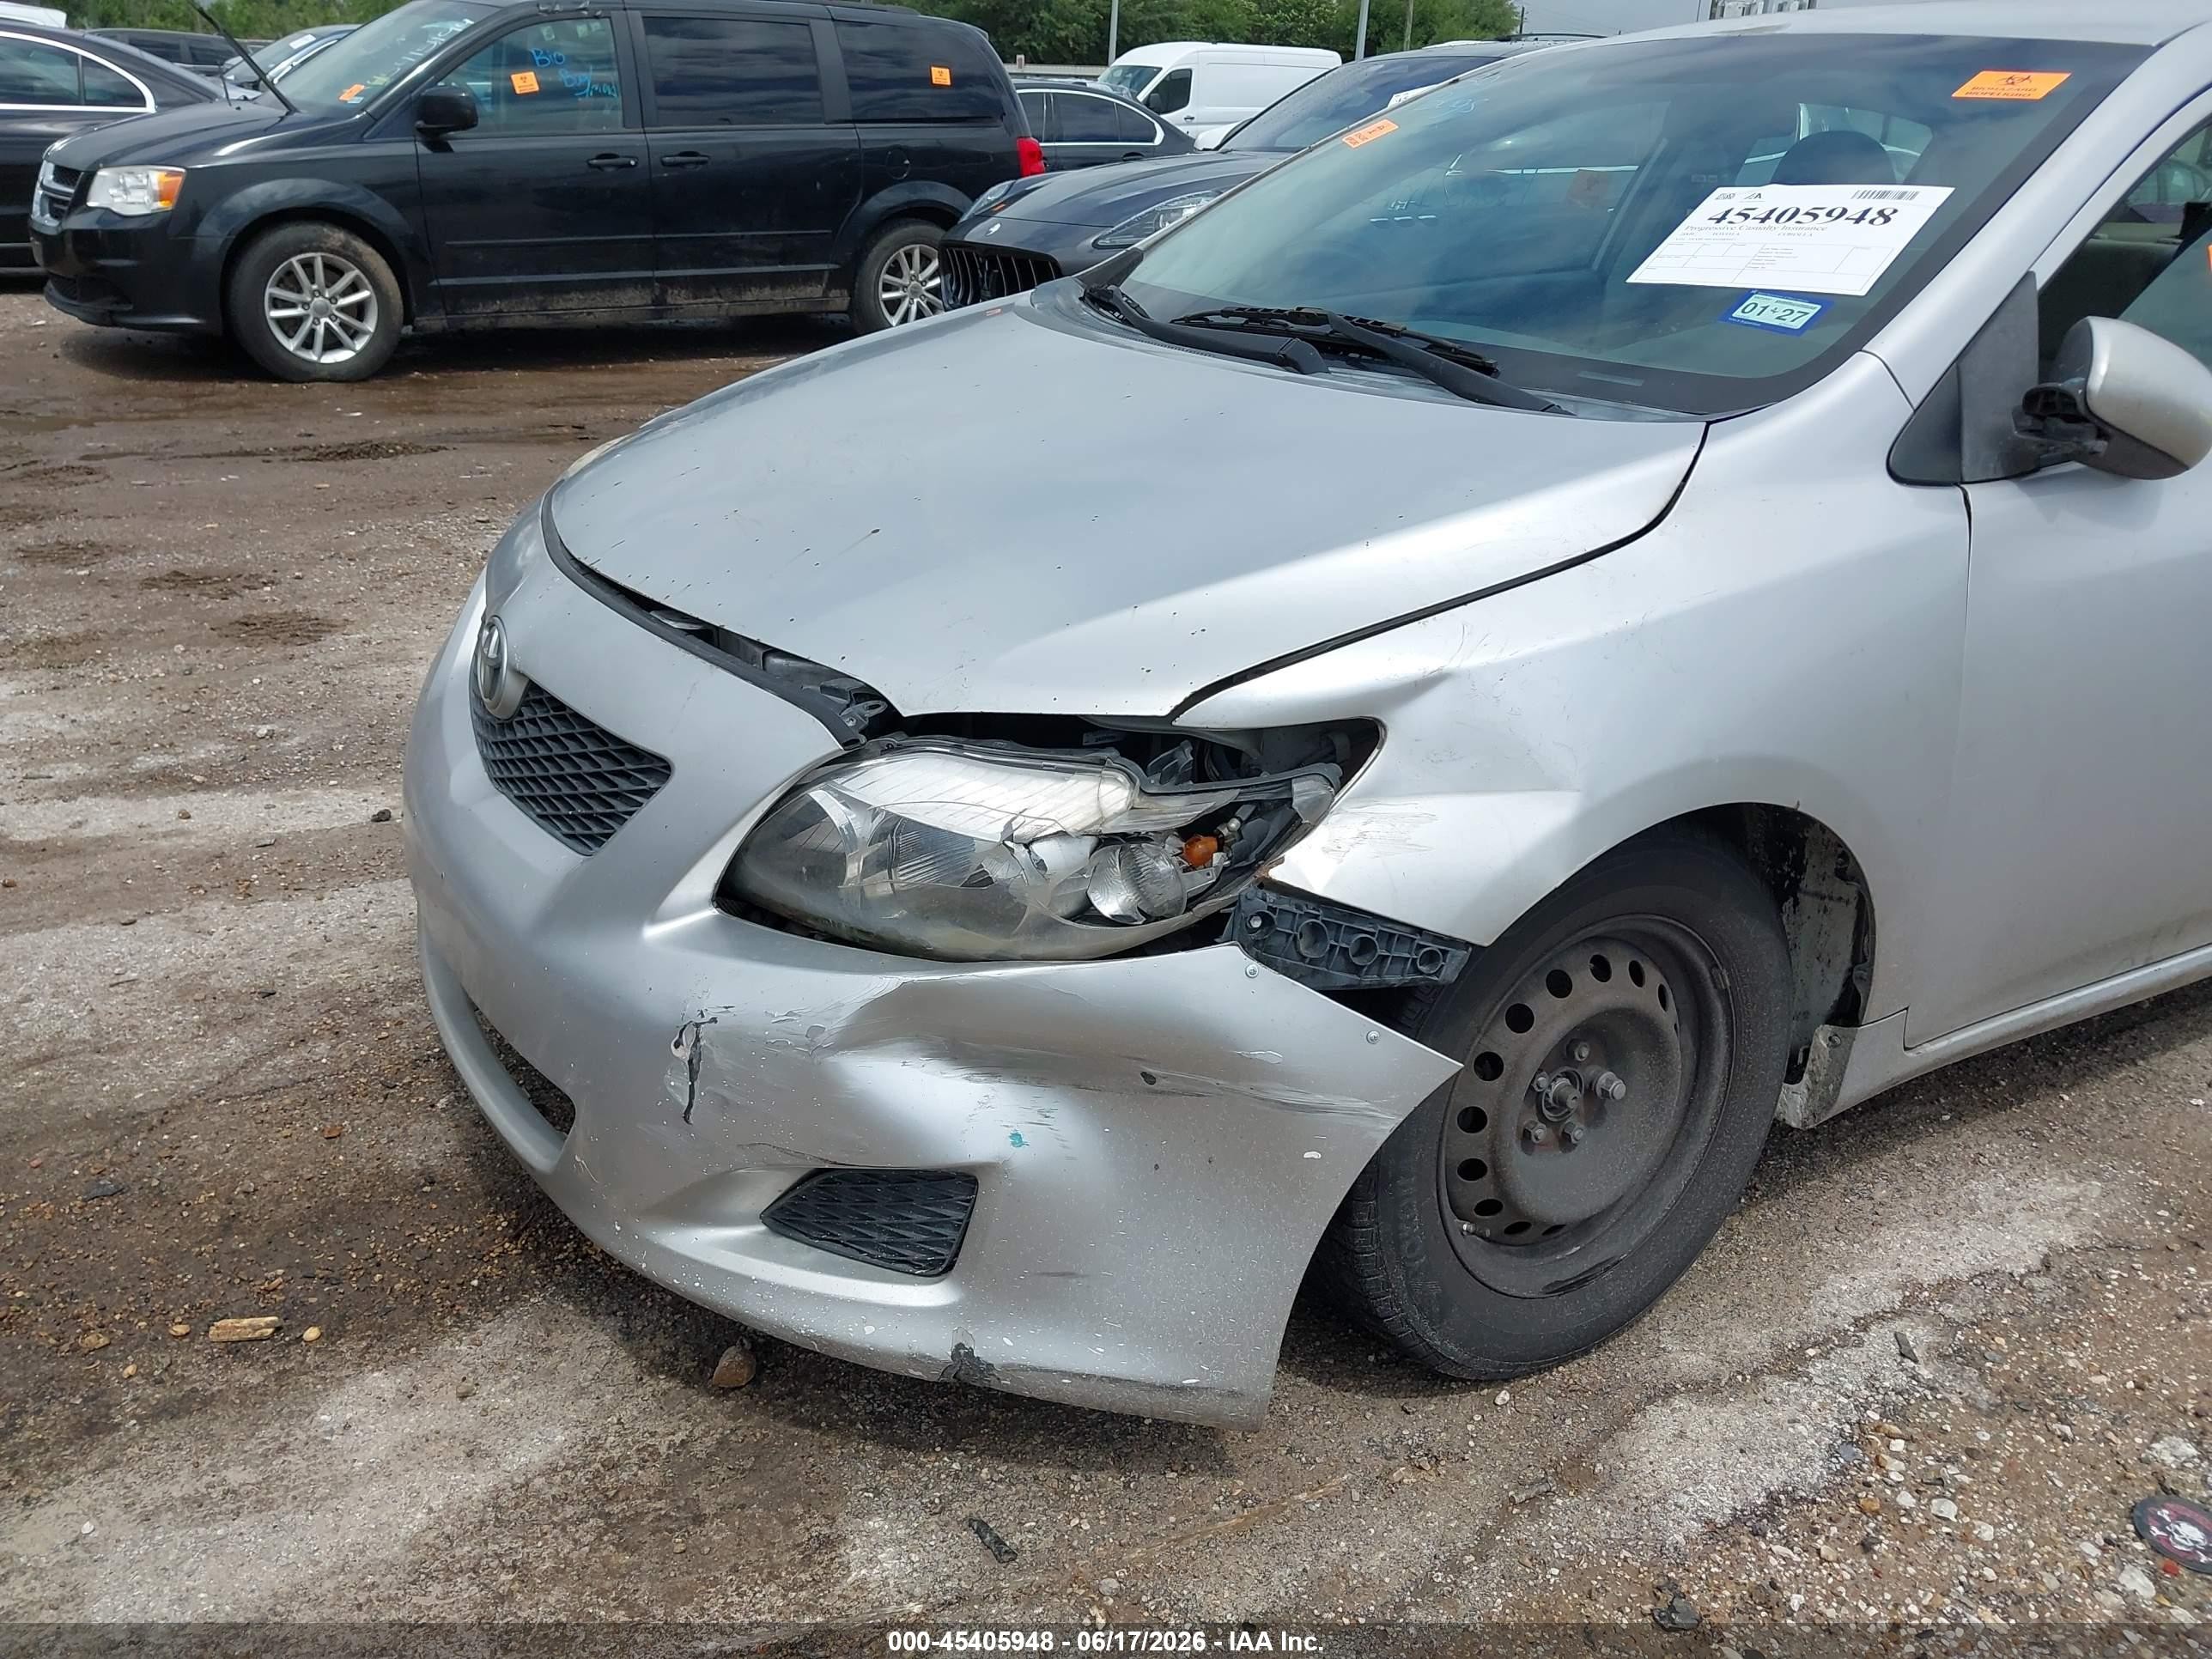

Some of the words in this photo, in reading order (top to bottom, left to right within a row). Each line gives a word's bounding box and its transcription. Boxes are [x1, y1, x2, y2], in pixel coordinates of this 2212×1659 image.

[1708, 206, 1898, 225] 45405948
[1741, 301, 1771, 317] 01
[1775, 308, 1810, 323] 27
